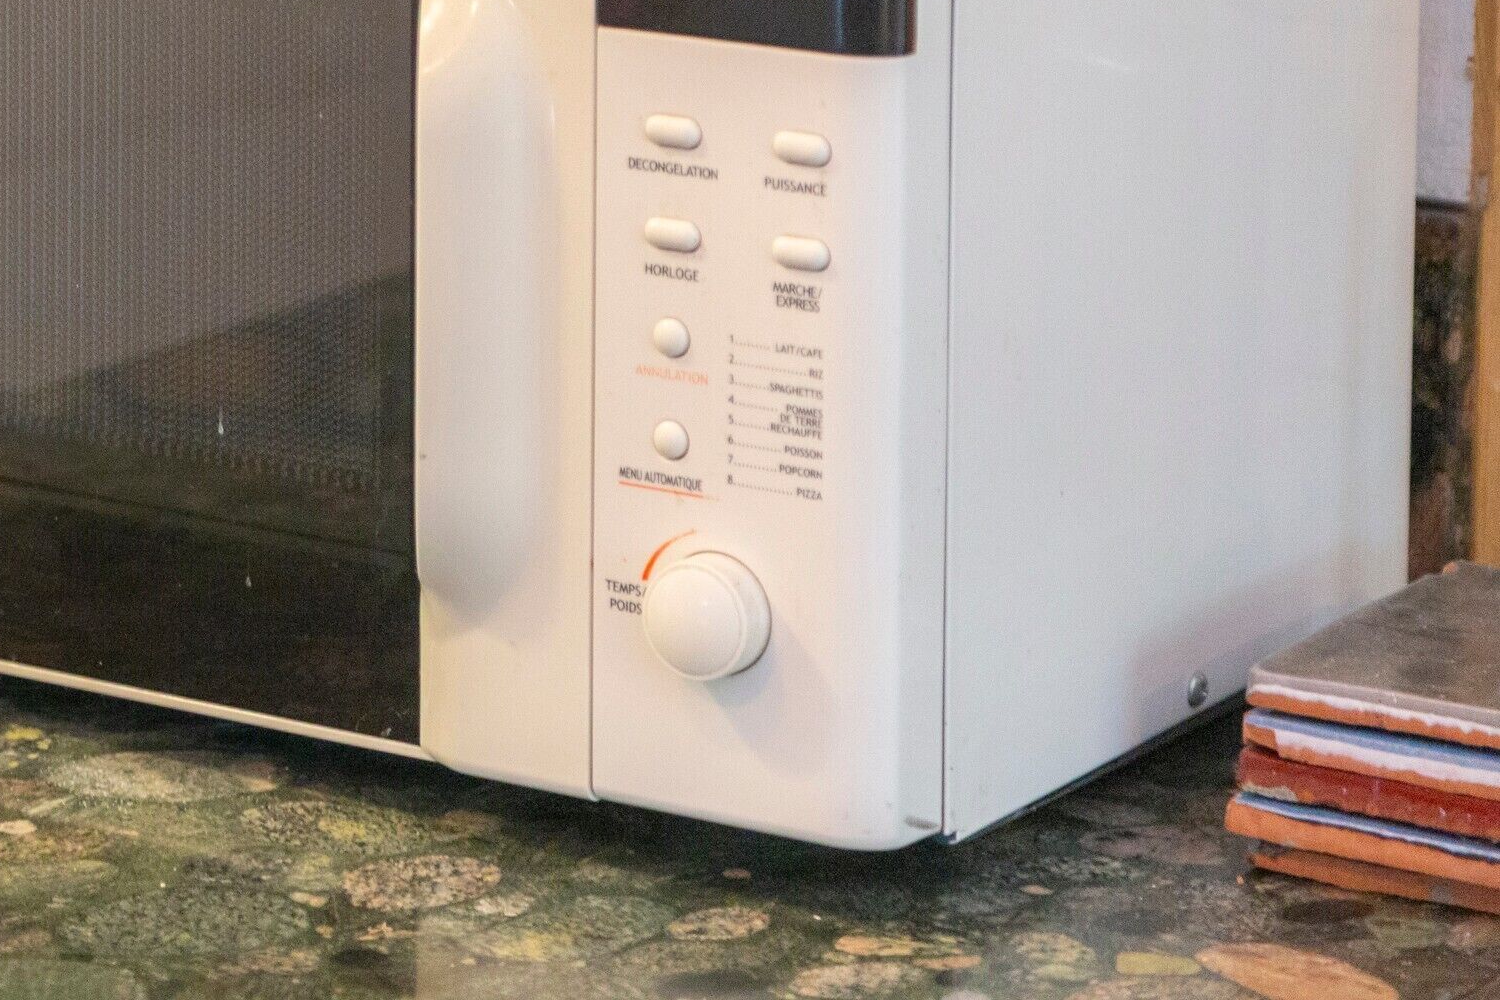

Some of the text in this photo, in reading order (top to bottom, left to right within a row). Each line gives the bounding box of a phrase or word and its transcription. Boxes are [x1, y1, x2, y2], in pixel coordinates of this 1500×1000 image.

[628, 157, 718, 179] DECONGELATION
[764, 177, 827, 196] PUISSANCE
[645, 263, 699, 282] HORLOGE
[773, 282, 822, 300] MARCHE/
[776, 295, 820, 312] EXPRESS
[636, 363, 708, 385] ANNULATION
[809, 368, 823, 380] RIZ
[769, 382, 823, 400] SPAGHETTIS
[786, 404, 823, 418] POMMES
[780, 412, 822, 429] DE TERRE
[784, 445, 823, 460] POISSON
[619, 466, 703, 491] MENU AUTOMATIQUE
[779, 464, 823, 480] POPCORN
[796, 487, 823, 500] PIZZA
[606, 579, 646, 598] TEMPS/
[609, 598, 643, 615] POIDS
